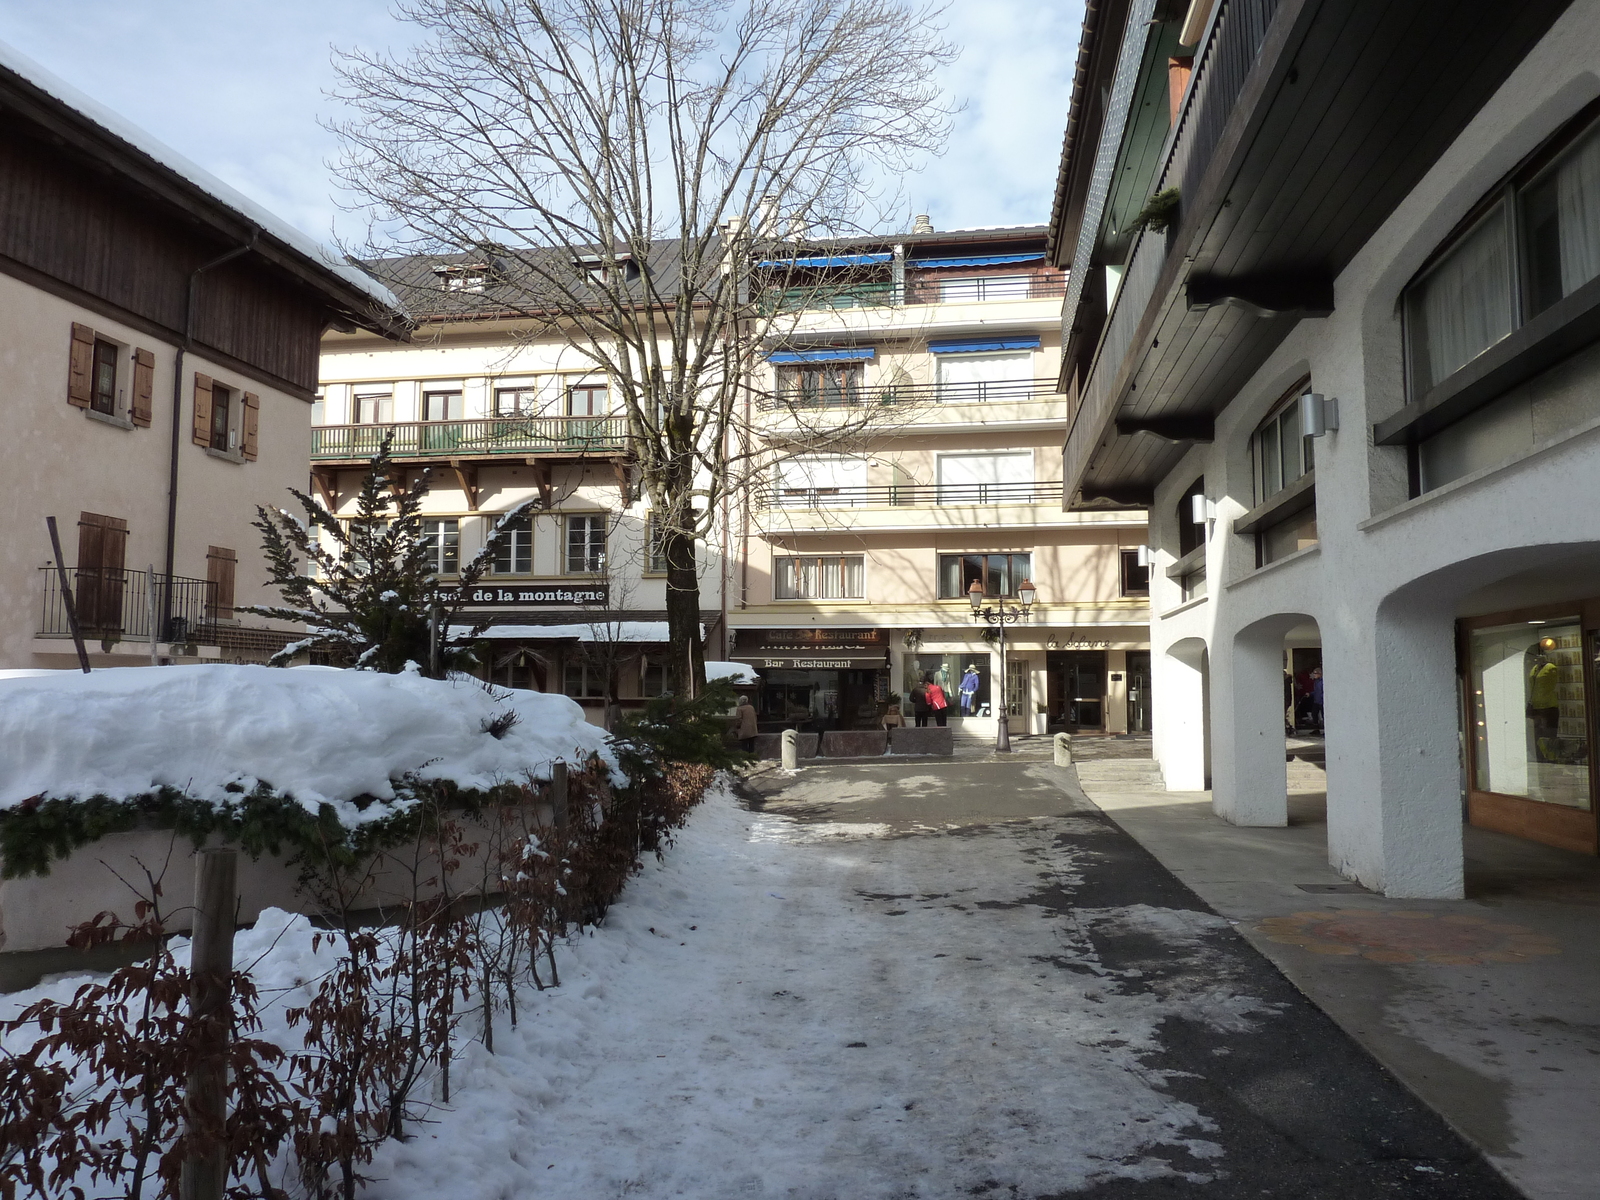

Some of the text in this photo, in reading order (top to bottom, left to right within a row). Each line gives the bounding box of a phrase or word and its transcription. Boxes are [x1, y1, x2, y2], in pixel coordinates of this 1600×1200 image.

[473, 590, 492, 602] de
[497, 590, 514, 602] la
[519, 590, 605, 603] montagne
[815, 628, 877, 640] Restaurant
[764, 659, 852, 668] Bar Restaurant
